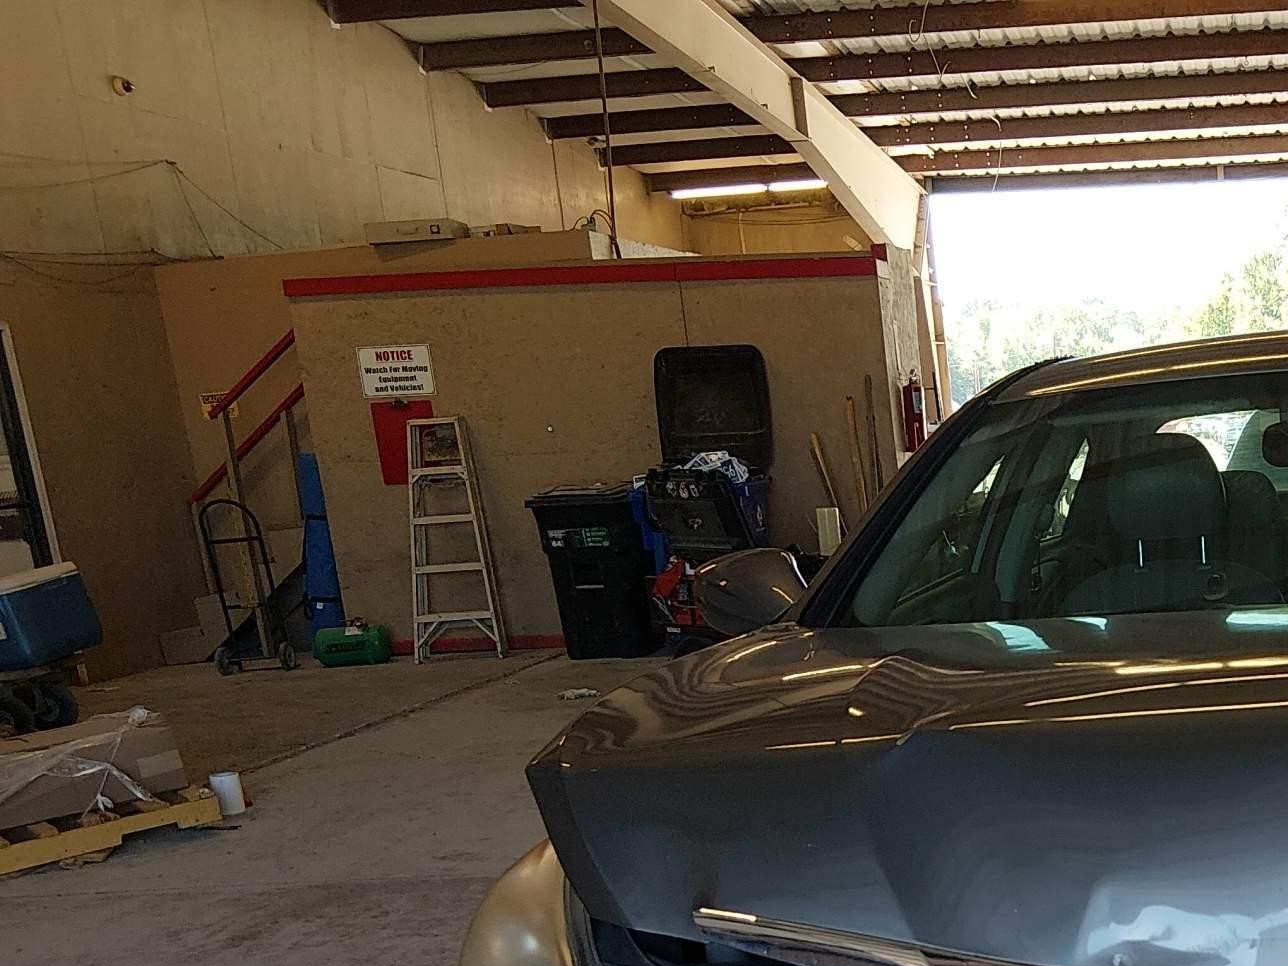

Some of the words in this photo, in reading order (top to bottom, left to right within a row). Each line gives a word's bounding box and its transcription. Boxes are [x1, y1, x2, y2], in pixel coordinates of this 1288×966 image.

[375, 350, 413, 361] NOTICE
[364, 366, 388, 374] Watch
[401, 365, 428, 373] Moving
[378, 375, 417, 383] Equipment
[390, 384, 424, 392] Vehicles!
